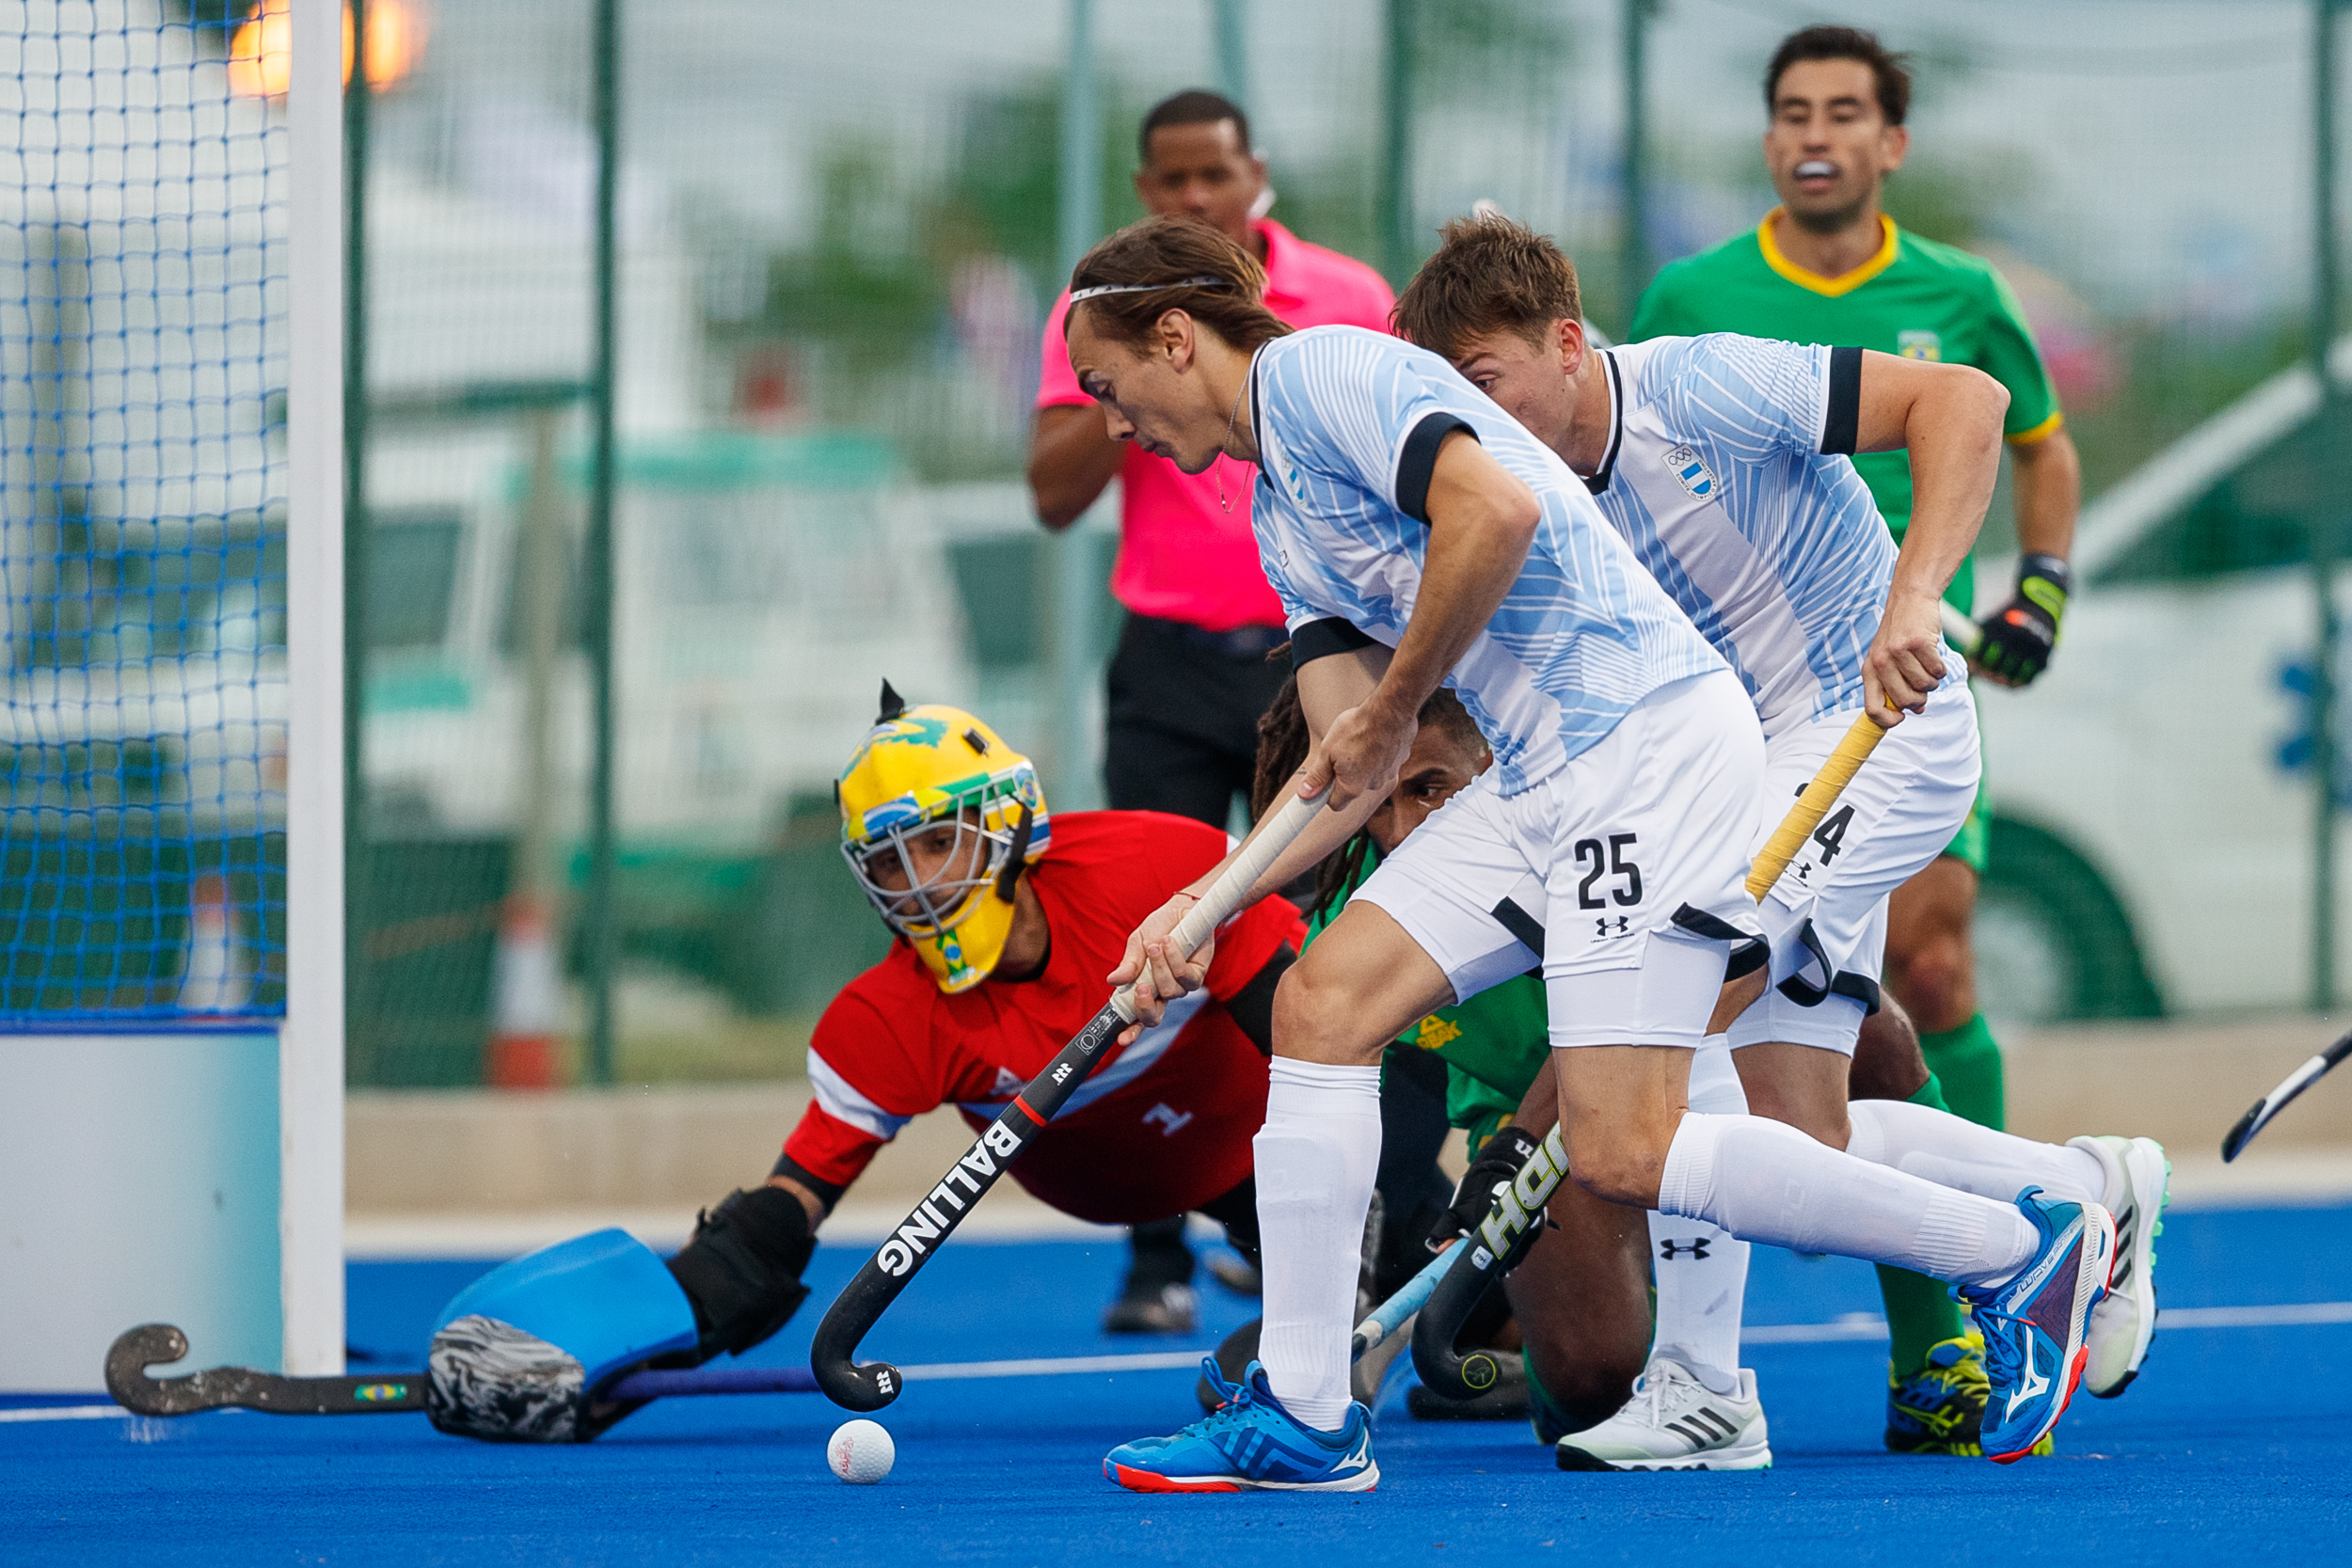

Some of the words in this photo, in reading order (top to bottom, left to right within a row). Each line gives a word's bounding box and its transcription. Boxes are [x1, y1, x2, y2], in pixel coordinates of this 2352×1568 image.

[1793, 783, 1856, 867] 4
[1574, 832, 1643, 910] 25
[877, 1118, 1023, 1276] BALLING
